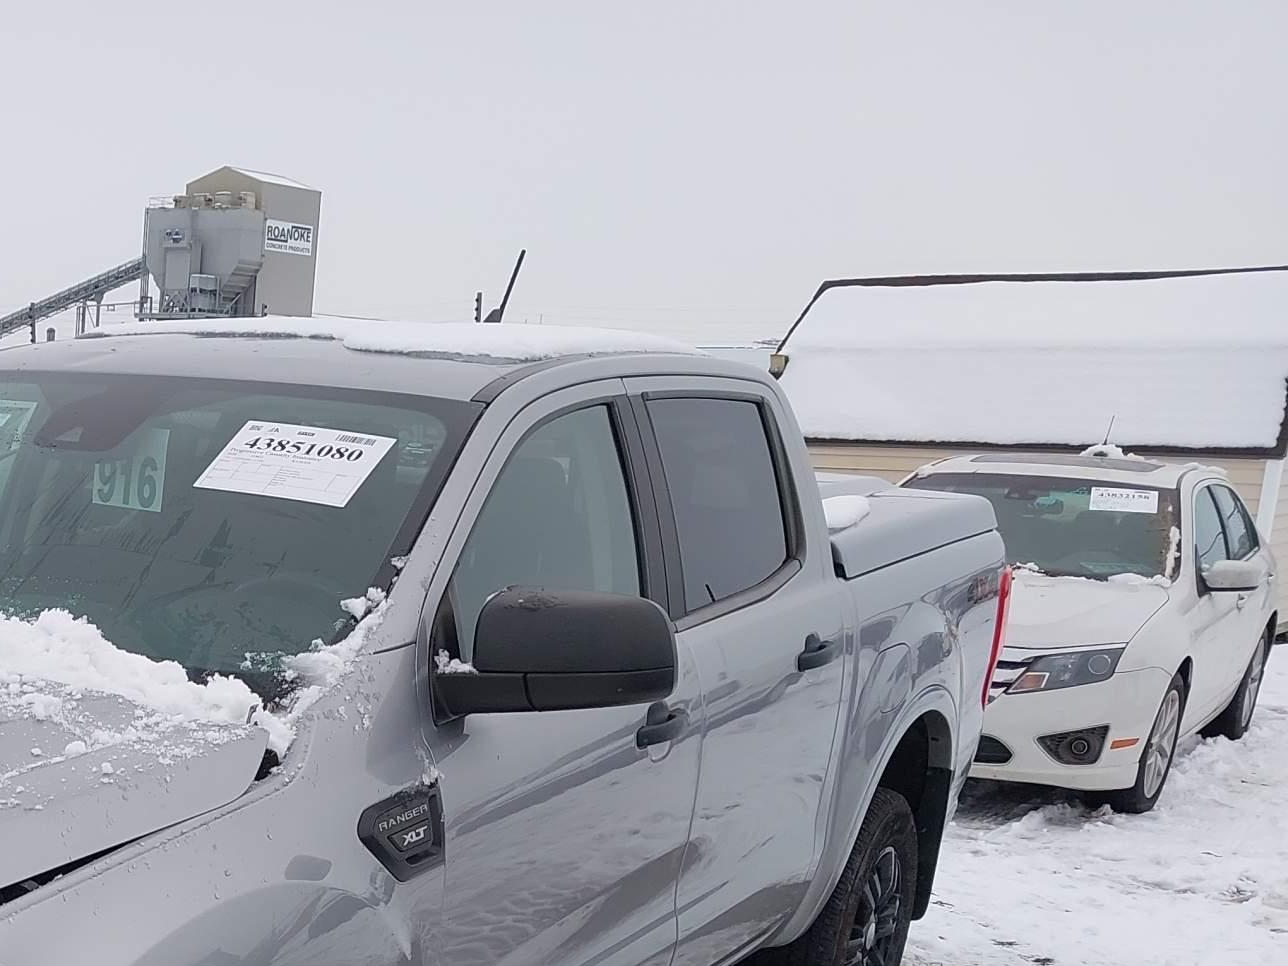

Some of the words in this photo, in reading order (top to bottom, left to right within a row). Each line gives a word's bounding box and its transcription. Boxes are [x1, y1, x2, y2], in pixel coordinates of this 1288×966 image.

[266, 225, 312, 243] ROANOKE
[266, 242, 288, 251] CONCRETE
[288, 245, 310, 254] PRODUCTS
[244, 436, 364, 462] 43851080
[95, 455, 158, 509] 916
[378, 803, 428, 833] RANGER
[402, 825, 428, 847] XLT
